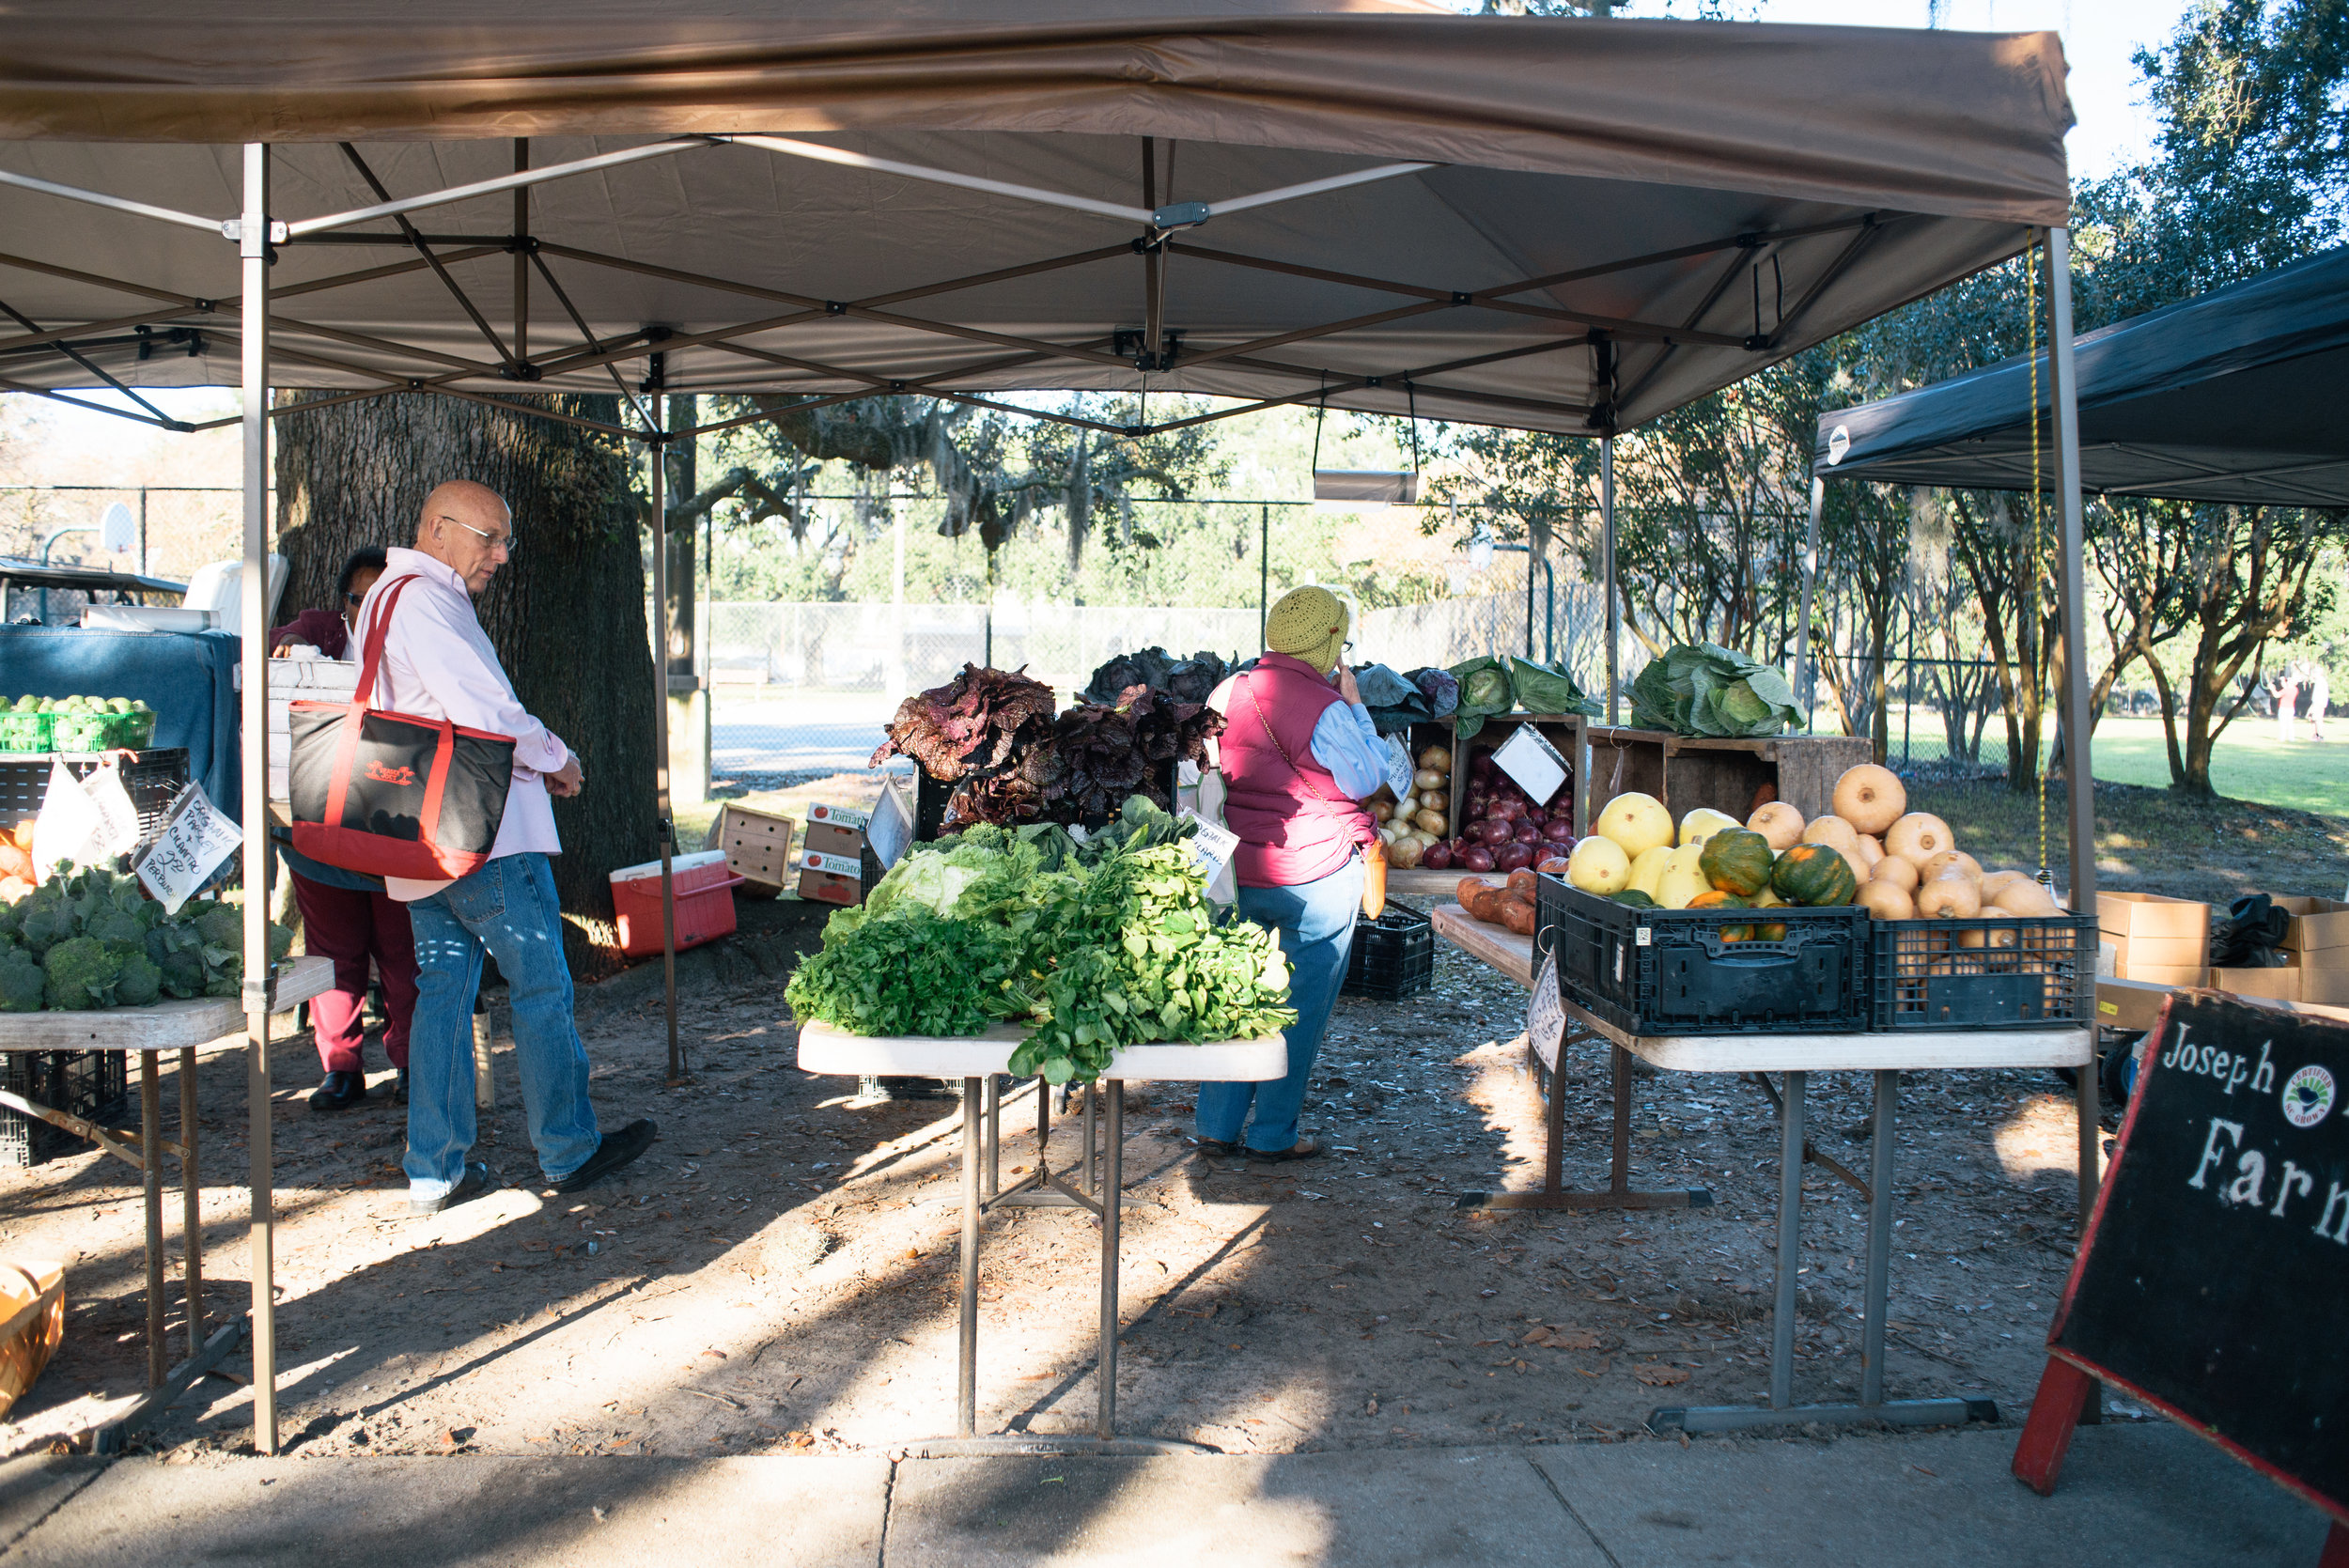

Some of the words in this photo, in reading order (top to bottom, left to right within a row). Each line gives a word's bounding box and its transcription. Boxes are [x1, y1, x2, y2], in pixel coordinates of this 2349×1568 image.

[184, 809, 222, 857] PARSLEY
[193, 800, 235, 844] ORGANIC
[169, 826, 201, 875] CILANTRO
[822, 856, 861, 875] Tomato
[2163, 1021, 2276, 1095] Joseph
[2291, 1067, 2332, 1089] CERTIFIED
[2284, 1103, 2295, 1117] SC
[2294, 1107, 2326, 1125] GROWN
